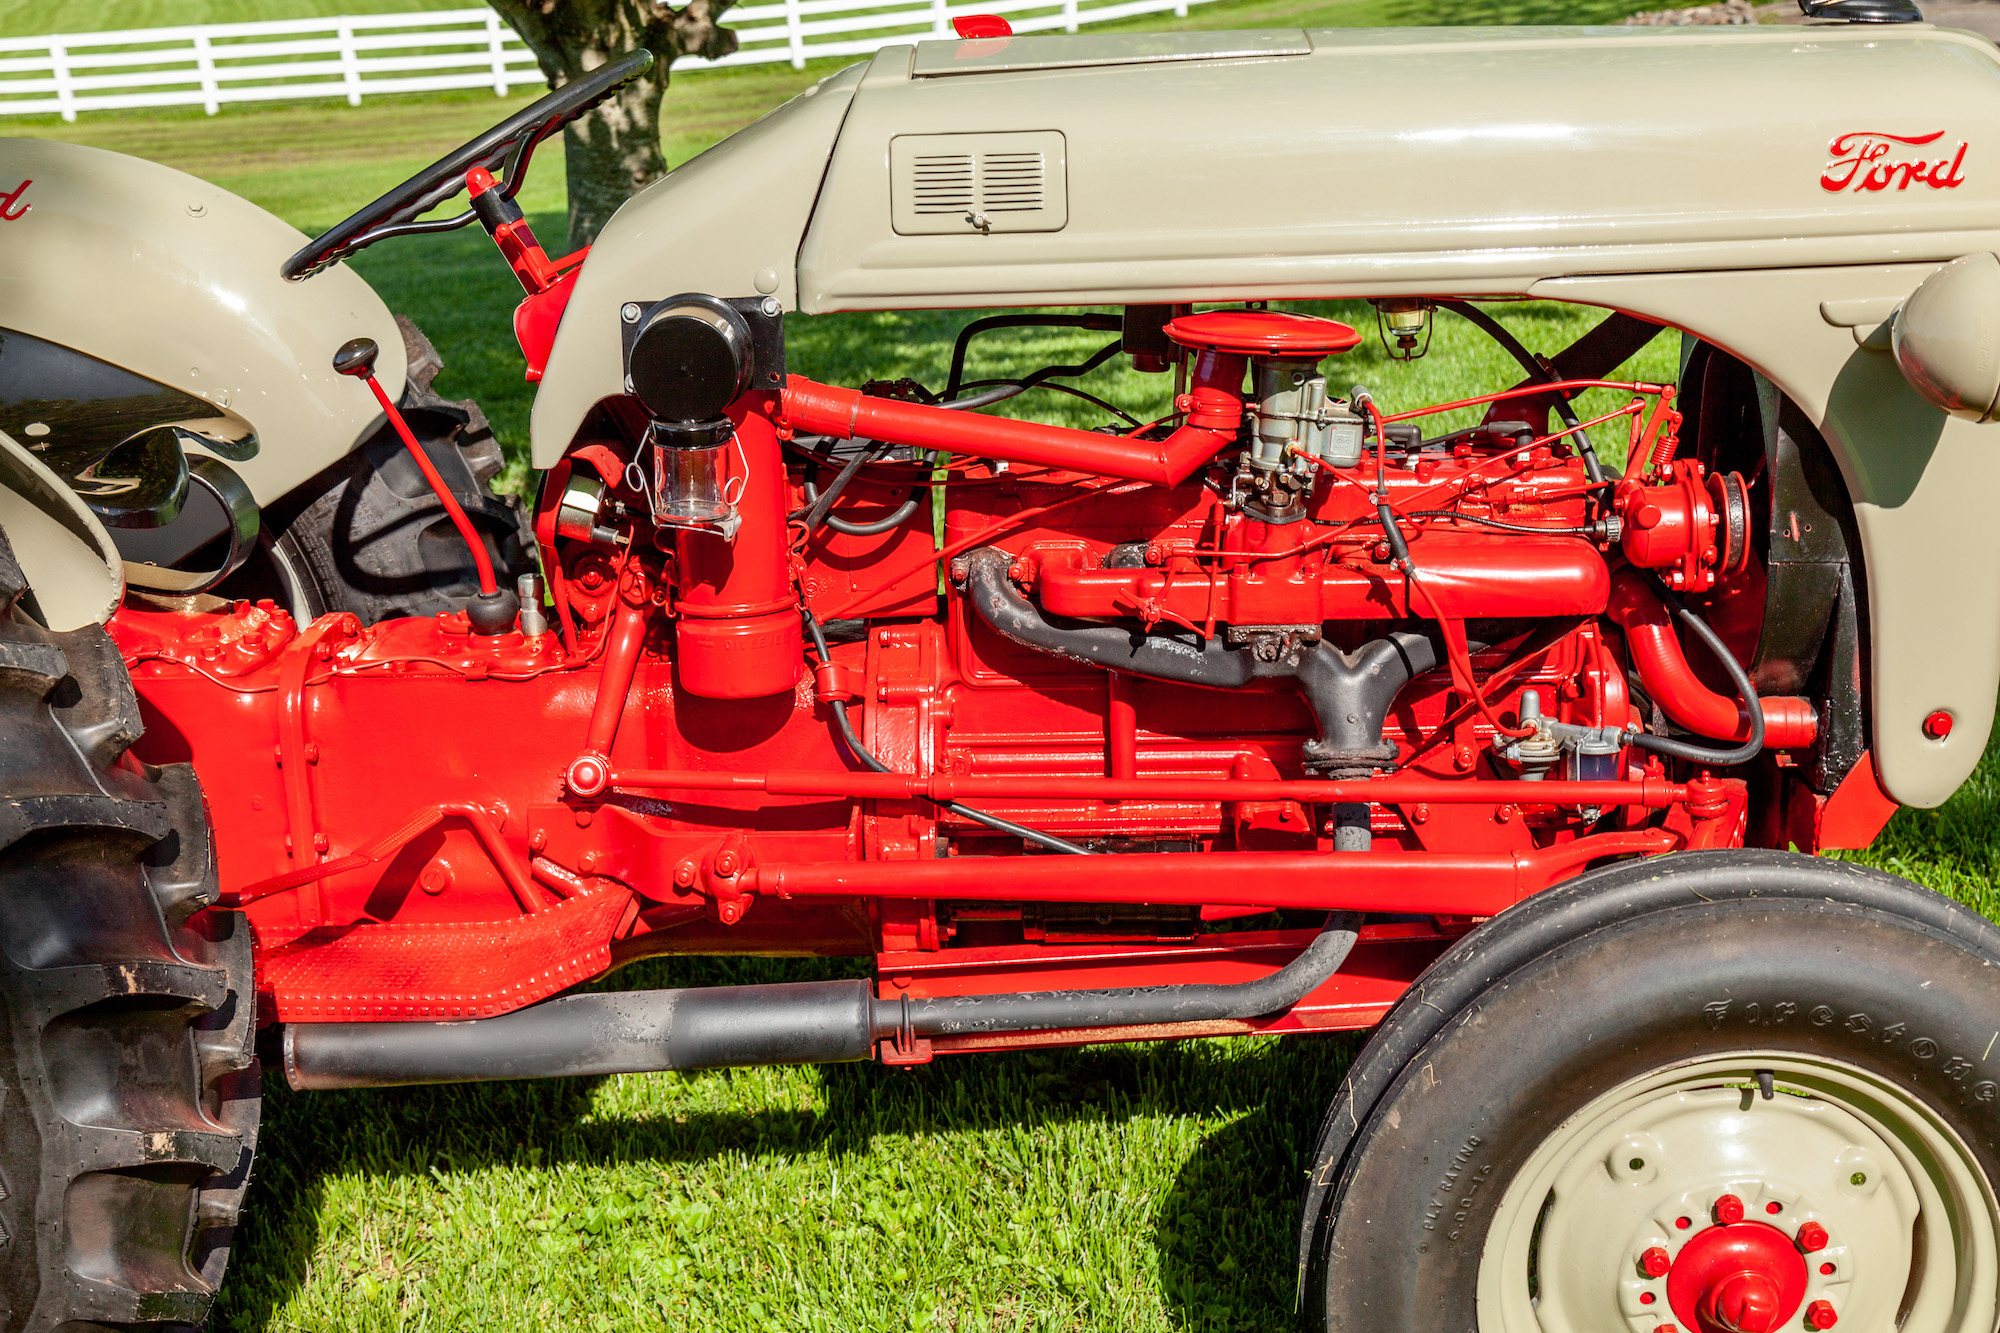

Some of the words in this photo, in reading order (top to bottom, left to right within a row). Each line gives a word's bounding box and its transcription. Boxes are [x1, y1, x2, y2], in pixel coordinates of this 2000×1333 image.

[1820, 130, 1969, 192] Ford
[1702, 998, 1999, 1102] Firestone
[1423, 1198, 1444, 1231] PLY
[1440, 1135, 1481, 1192] RATING
